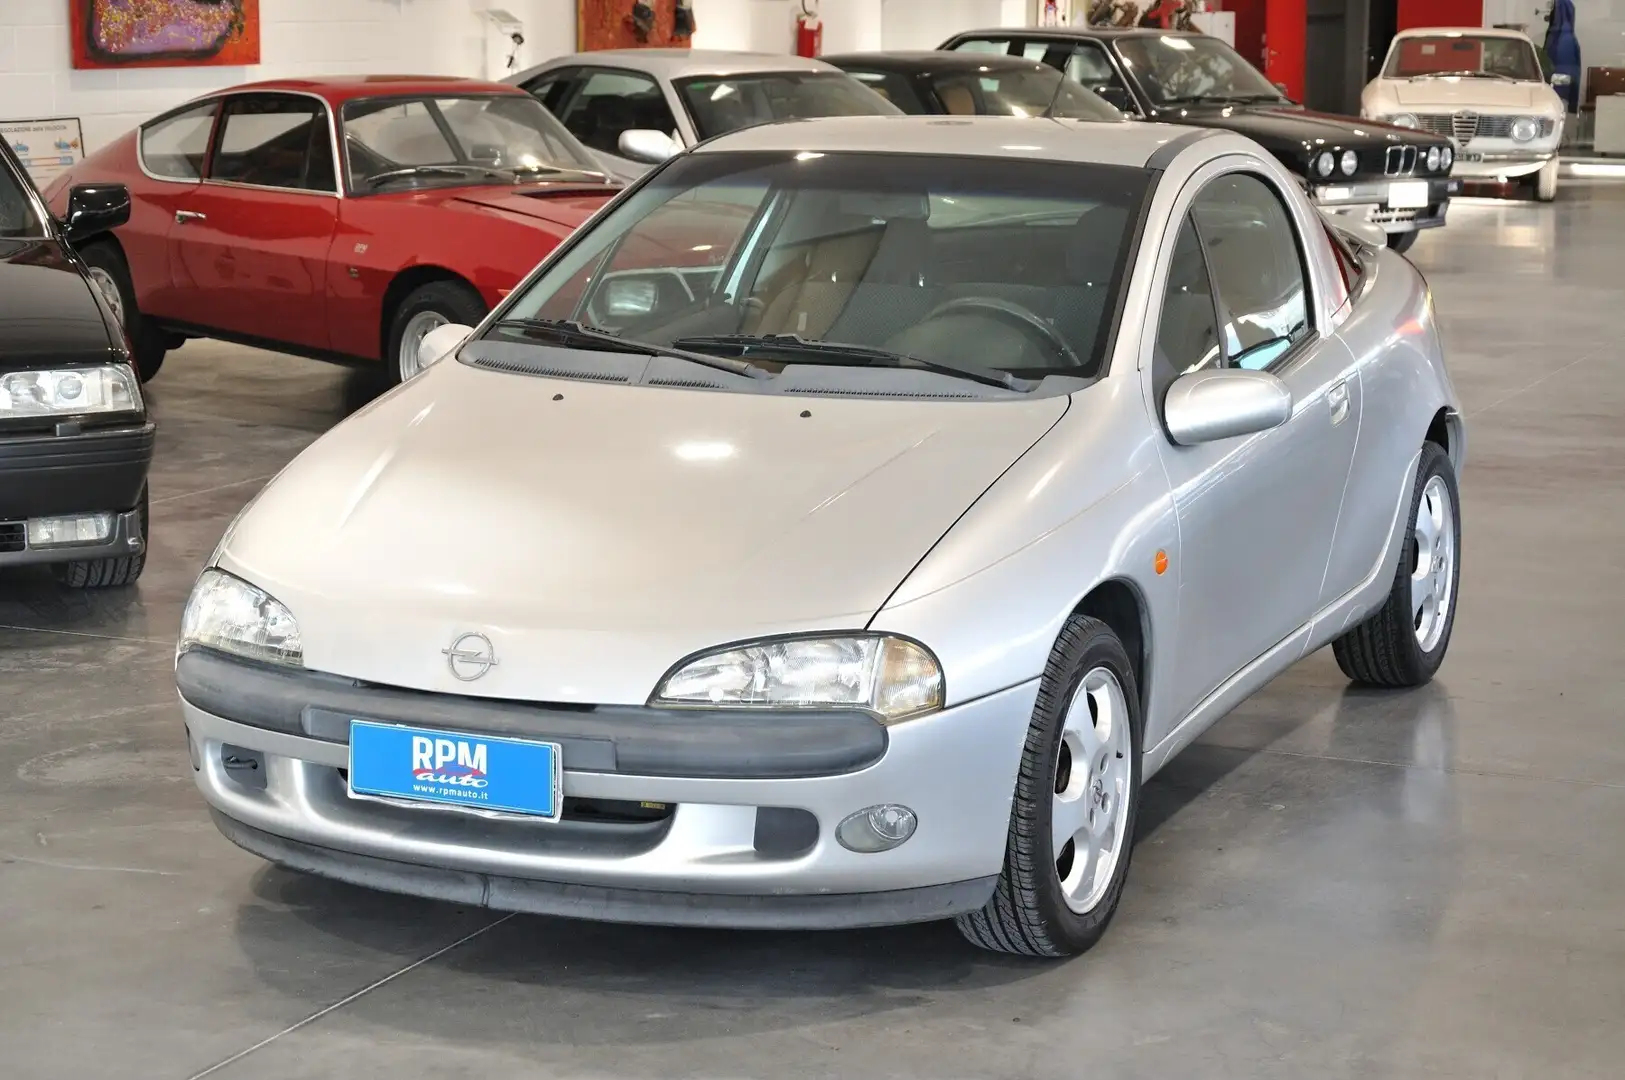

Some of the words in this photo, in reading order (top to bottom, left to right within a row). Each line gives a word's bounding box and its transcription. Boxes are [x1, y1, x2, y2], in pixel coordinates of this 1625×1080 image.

[412, 735, 488, 775] RPM
[415, 772, 489, 788] auto
[413, 784, 489, 800] www.rpmauto.it
